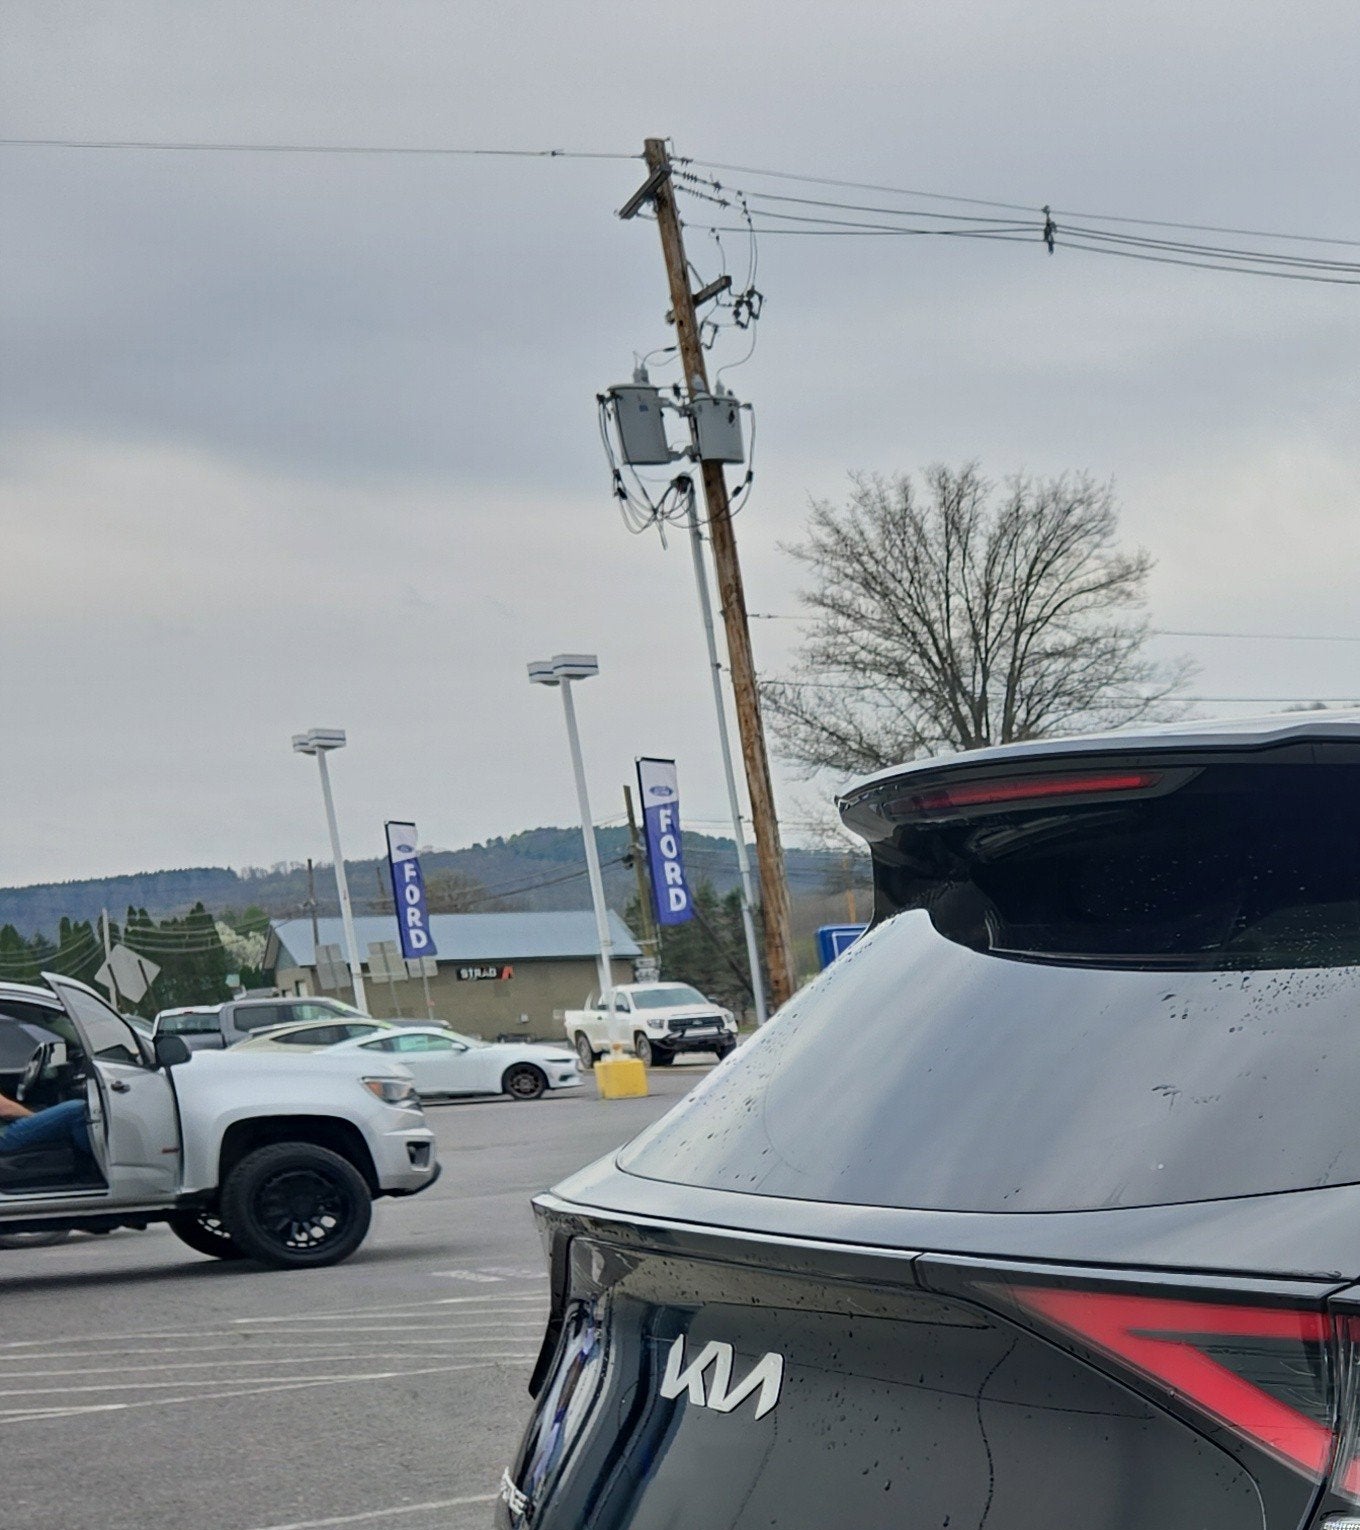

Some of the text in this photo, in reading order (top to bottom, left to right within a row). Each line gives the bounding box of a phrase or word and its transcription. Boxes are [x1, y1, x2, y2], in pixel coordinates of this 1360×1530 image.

[659, 809, 687, 912] FORD
[404, 863, 428, 949] FORD
[660, 1333, 784, 1421] KIA
